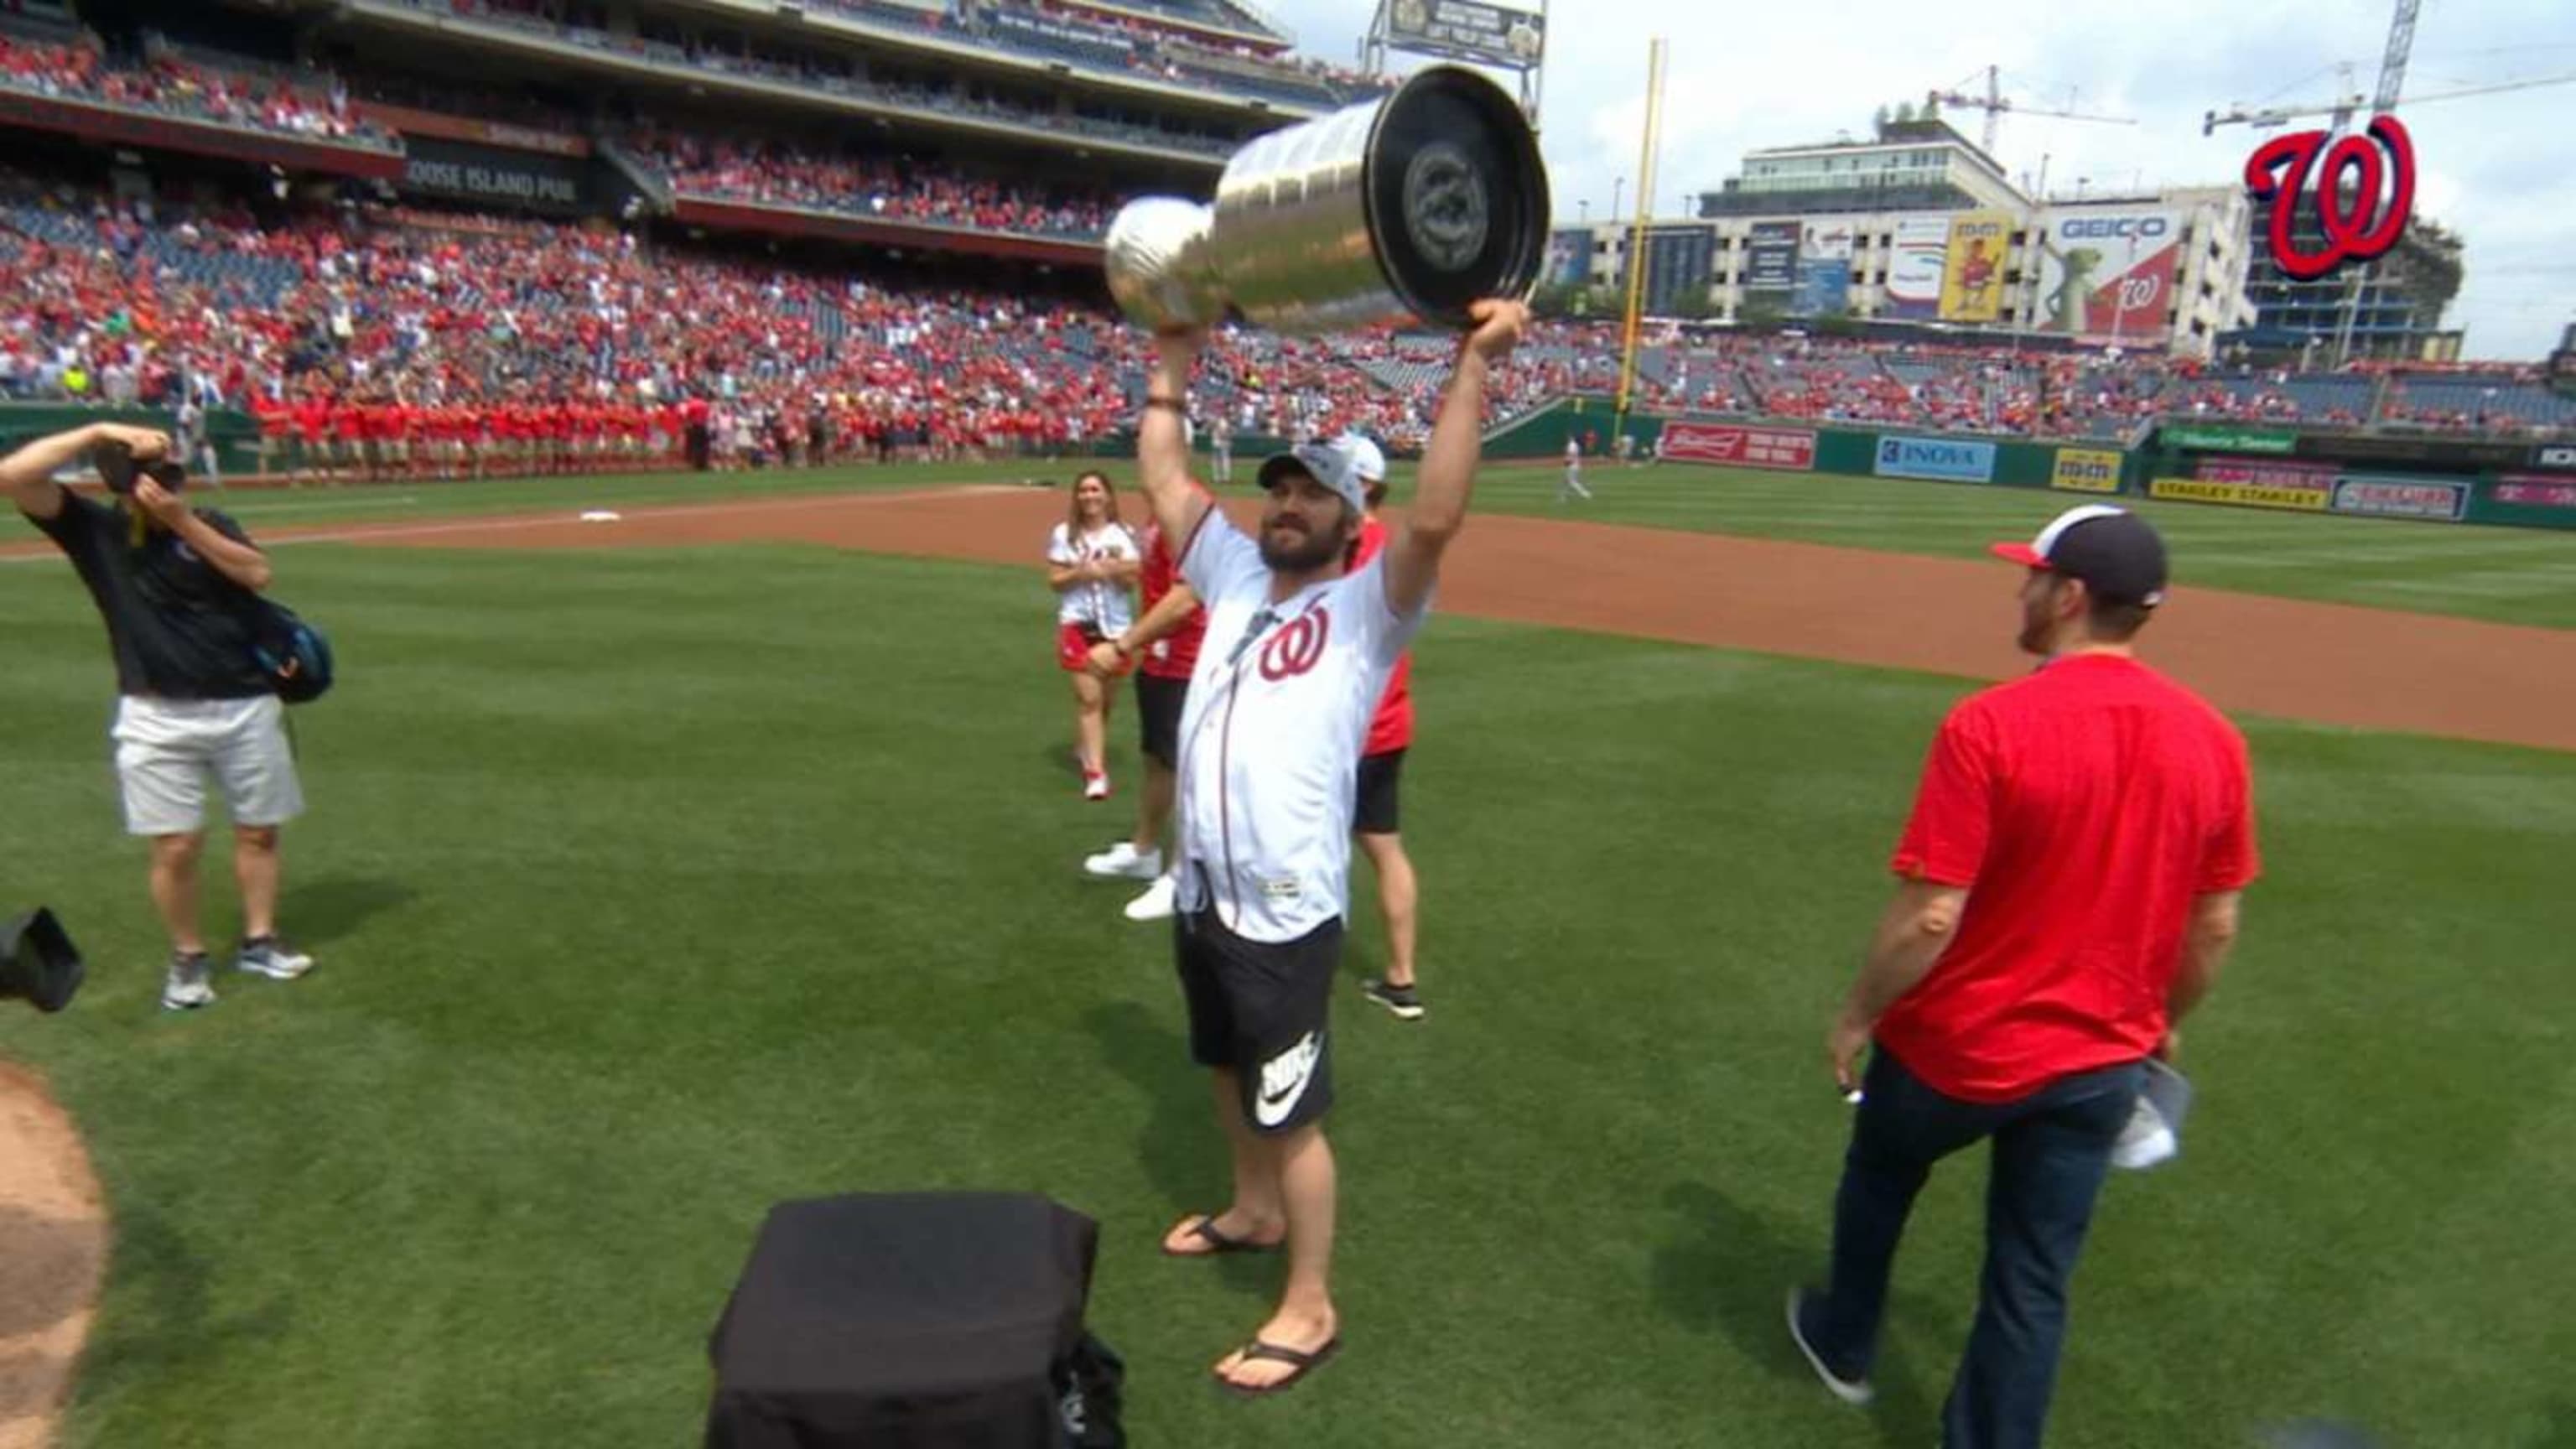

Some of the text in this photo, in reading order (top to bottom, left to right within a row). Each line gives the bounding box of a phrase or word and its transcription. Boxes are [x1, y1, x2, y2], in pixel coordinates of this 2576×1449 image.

[407, 159, 460, 190] OOSE
[465, 167, 534, 199] ISLAND
[2060, 217, 2167, 238] GEICO
[1904, 441, 1976, 465] INOVA
[2156, 481, 2320, 506] STANLEY STANLEY
